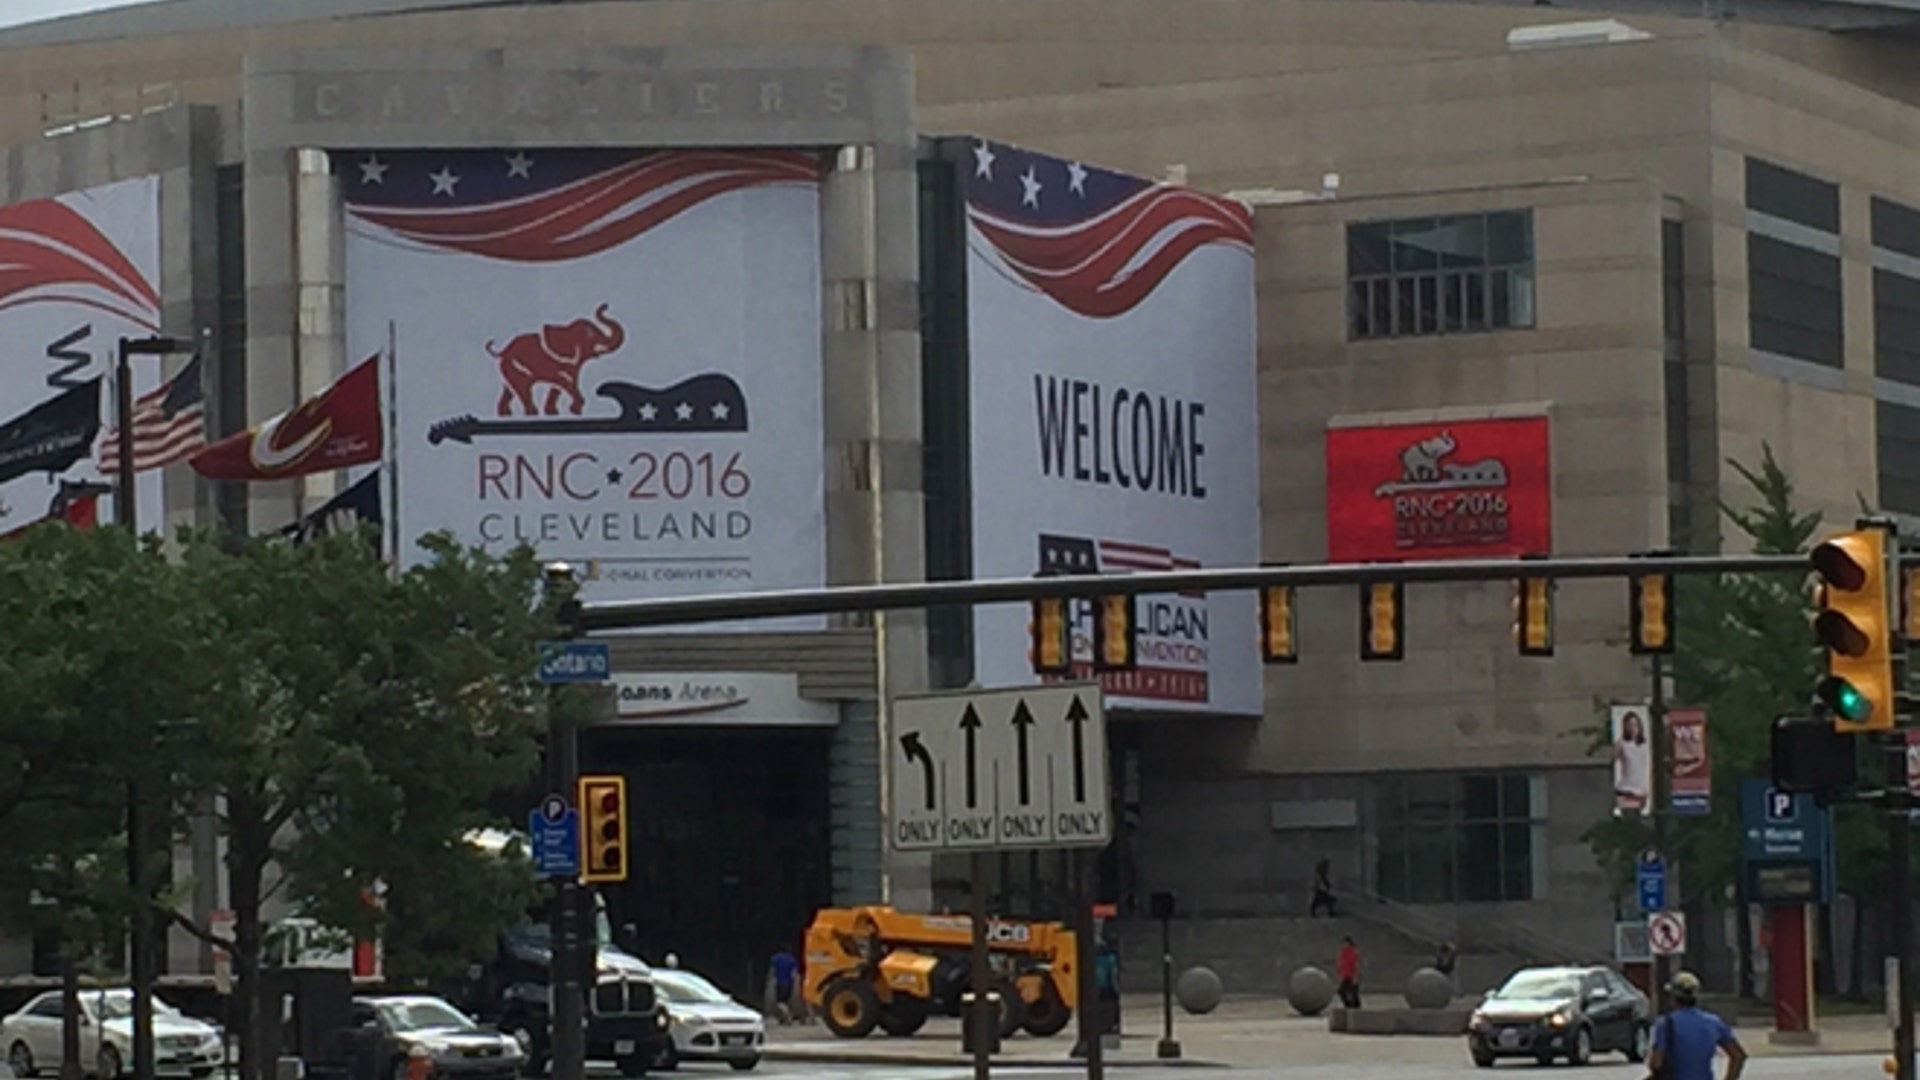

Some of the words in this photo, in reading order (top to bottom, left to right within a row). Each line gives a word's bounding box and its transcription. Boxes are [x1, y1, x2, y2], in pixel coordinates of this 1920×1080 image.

[1034, 373, 1206, 499] WELCOME
[479, 452, 599, 500] RNC
[628, 451, 751, 499] 2016
[1395, 496, 1446, 517] RNC
[479, 511, 752, 541] CLEVELAND
[678, 682, 738, 701] Arena
[899, 818, 940, 842] ONLY
[951, 816, 992, 840] ONLY
[1002, 814, 1045, 838] ONLY
[1057, 811, 1102, 835] ONLY
